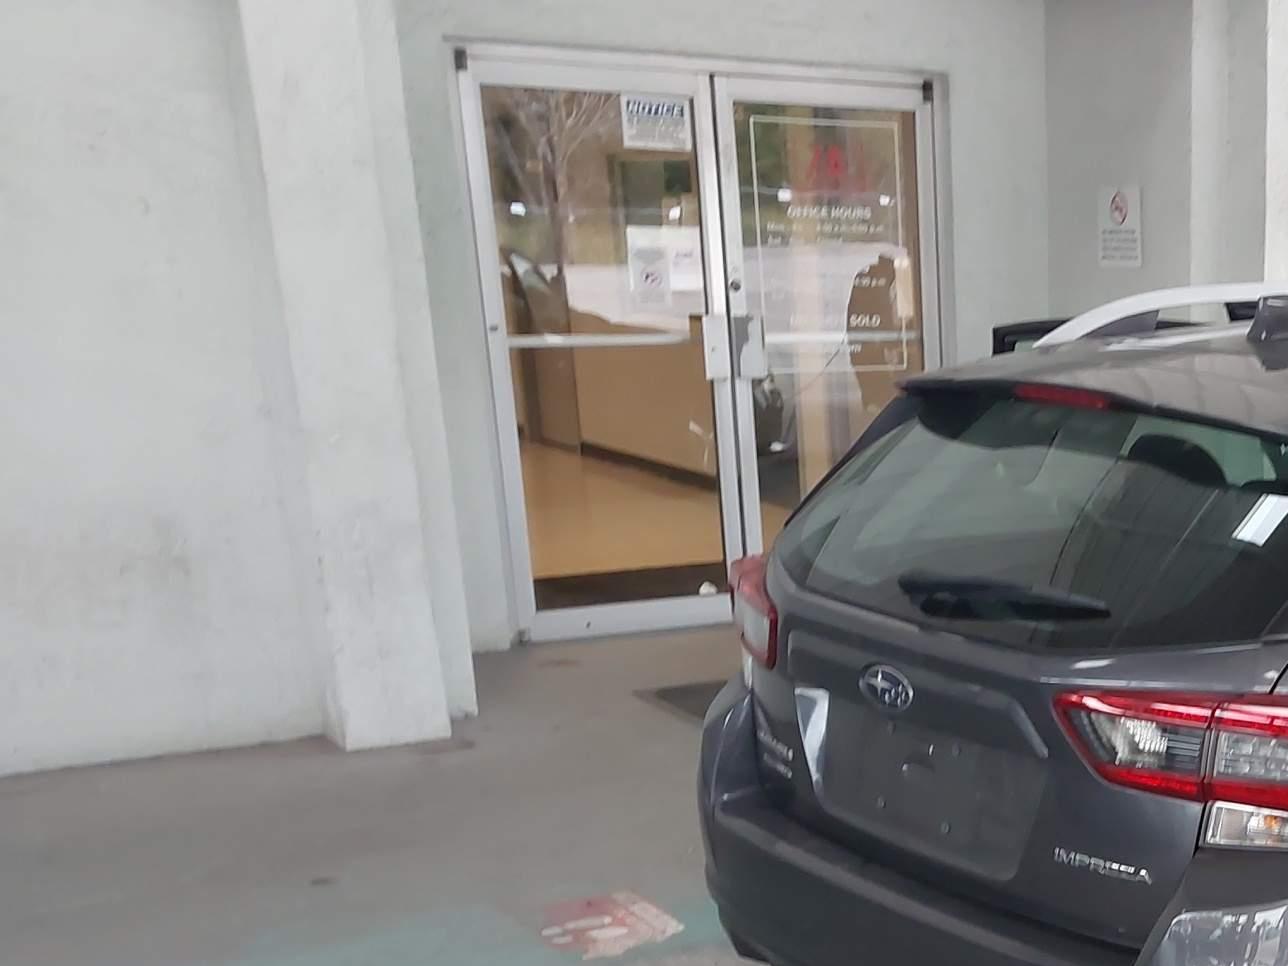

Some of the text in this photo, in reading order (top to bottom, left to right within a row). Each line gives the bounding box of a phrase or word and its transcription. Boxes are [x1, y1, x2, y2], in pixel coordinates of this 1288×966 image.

[625, 99, 685, 118] NOTICE
[786, 203, 872, 219] OFFICE HOURS
[849, 313, 881, 328] SOLD
